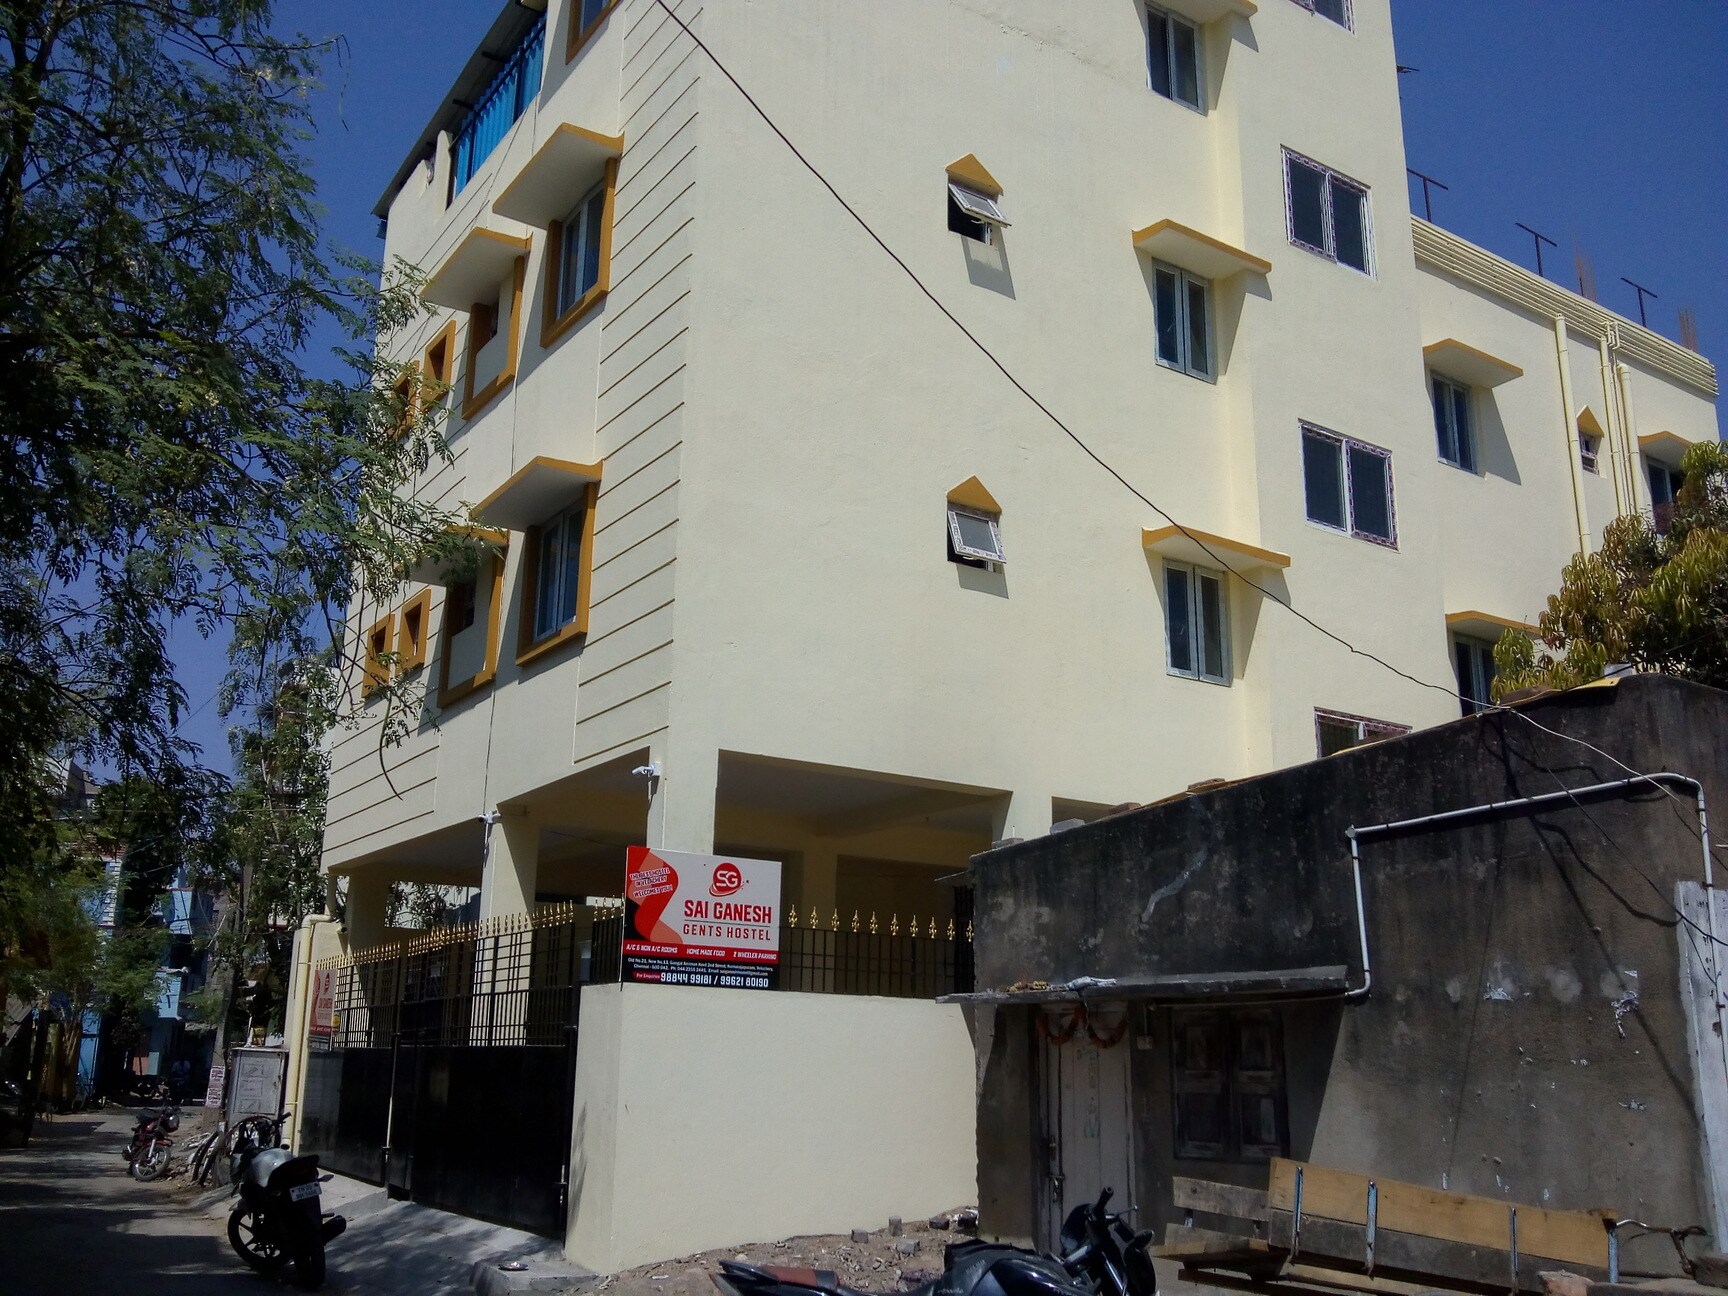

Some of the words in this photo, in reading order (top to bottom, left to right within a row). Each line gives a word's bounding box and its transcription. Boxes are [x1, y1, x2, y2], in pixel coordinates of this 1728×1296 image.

[716, 870, 738, 888] SG
[684, 899, 709, 919] SAI
[714, 902, 772, 924] GANESH
[683, 924, 722, 937] GENTS
[727, 928, 771, 940] HOSTEL
[661, 972, 688, 983] 98844
[690, 974, 712, 984] 99181
[720, 976, 744, 986] 99621
[746, 977, 769, 987] 80190
